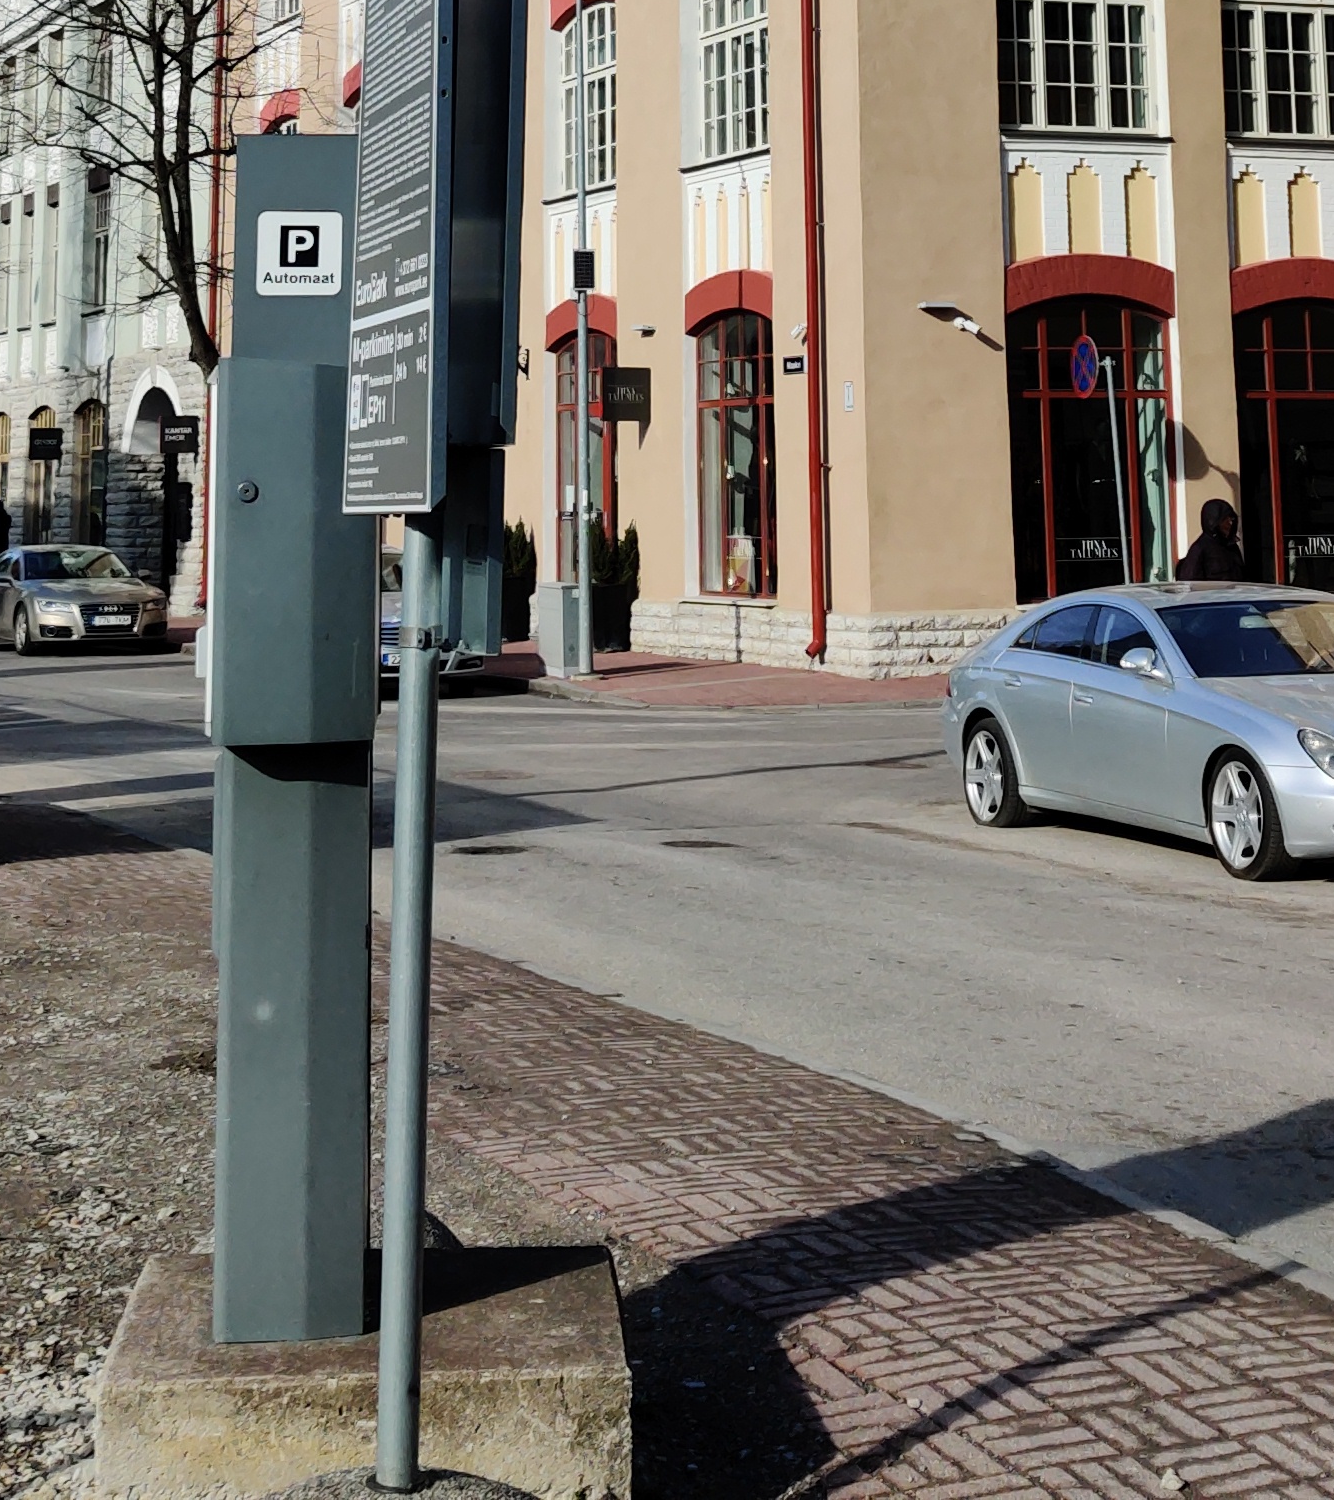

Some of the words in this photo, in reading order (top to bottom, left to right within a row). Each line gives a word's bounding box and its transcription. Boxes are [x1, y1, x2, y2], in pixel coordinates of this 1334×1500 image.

[287, 229, 315, 264] P
[262, 271, 336, 284] Automaat
[368, 395, 386, 424] EP11
